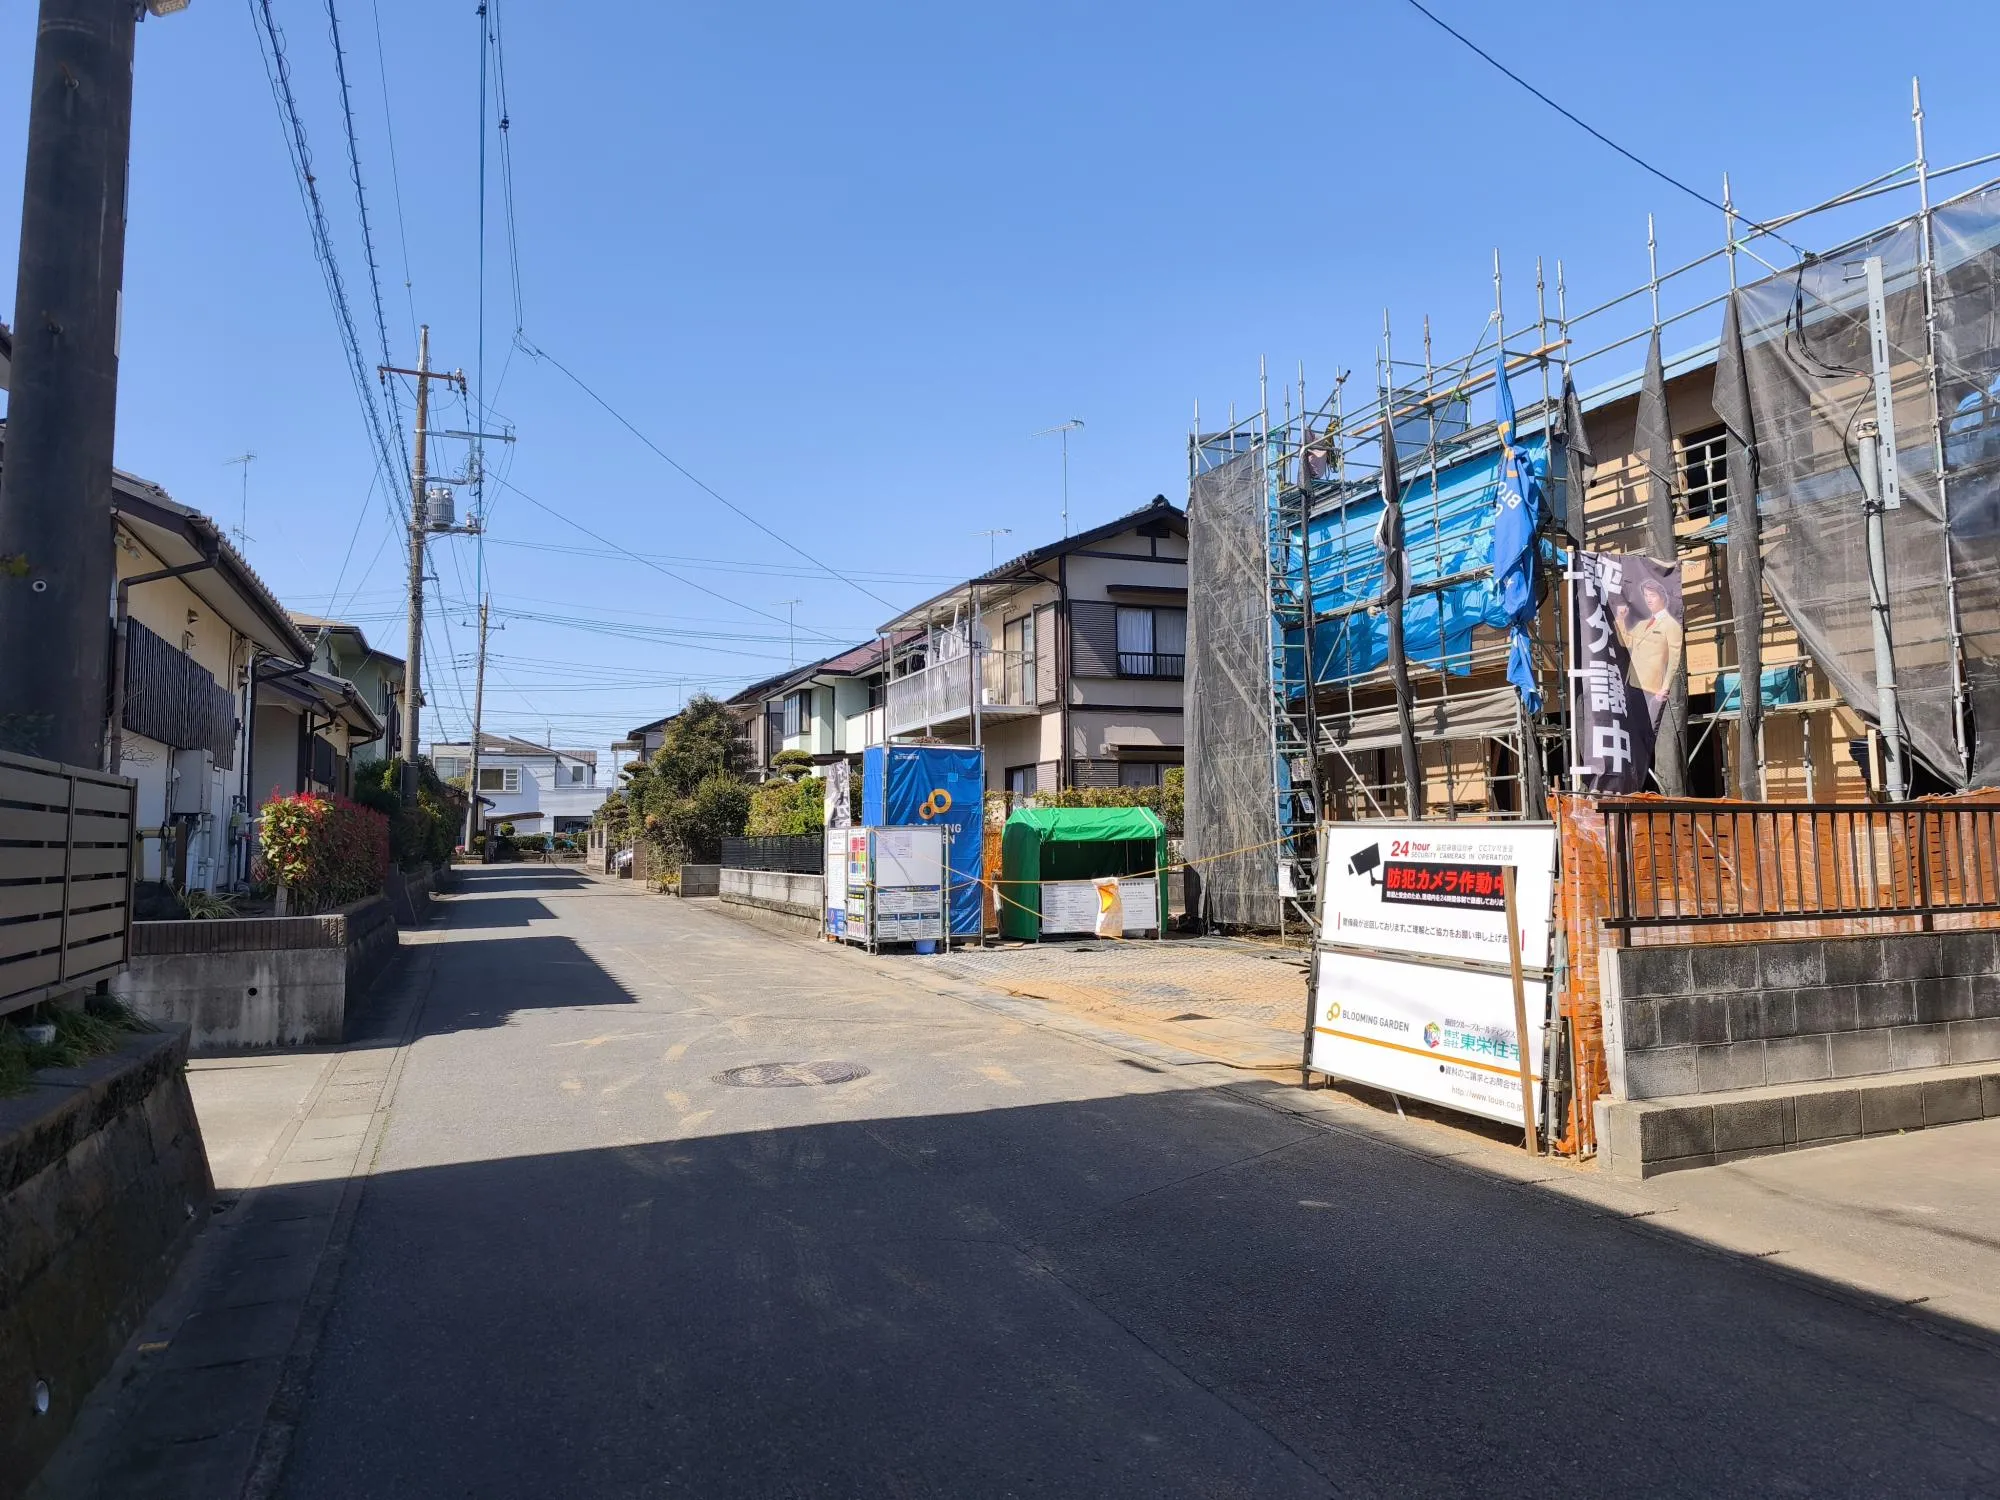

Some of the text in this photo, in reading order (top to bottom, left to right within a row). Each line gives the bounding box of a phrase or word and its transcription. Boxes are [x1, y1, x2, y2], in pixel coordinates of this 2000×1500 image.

[1390, 840, 1410, 857] 24
[1412, 841, 1431, 851] hour
[1411, 851, 1436, 859] SECURITY
[1477, 853, 1513, 861] OPERATION
[1342, 1009, 1410, 1033] BLOOMING GARDEN
